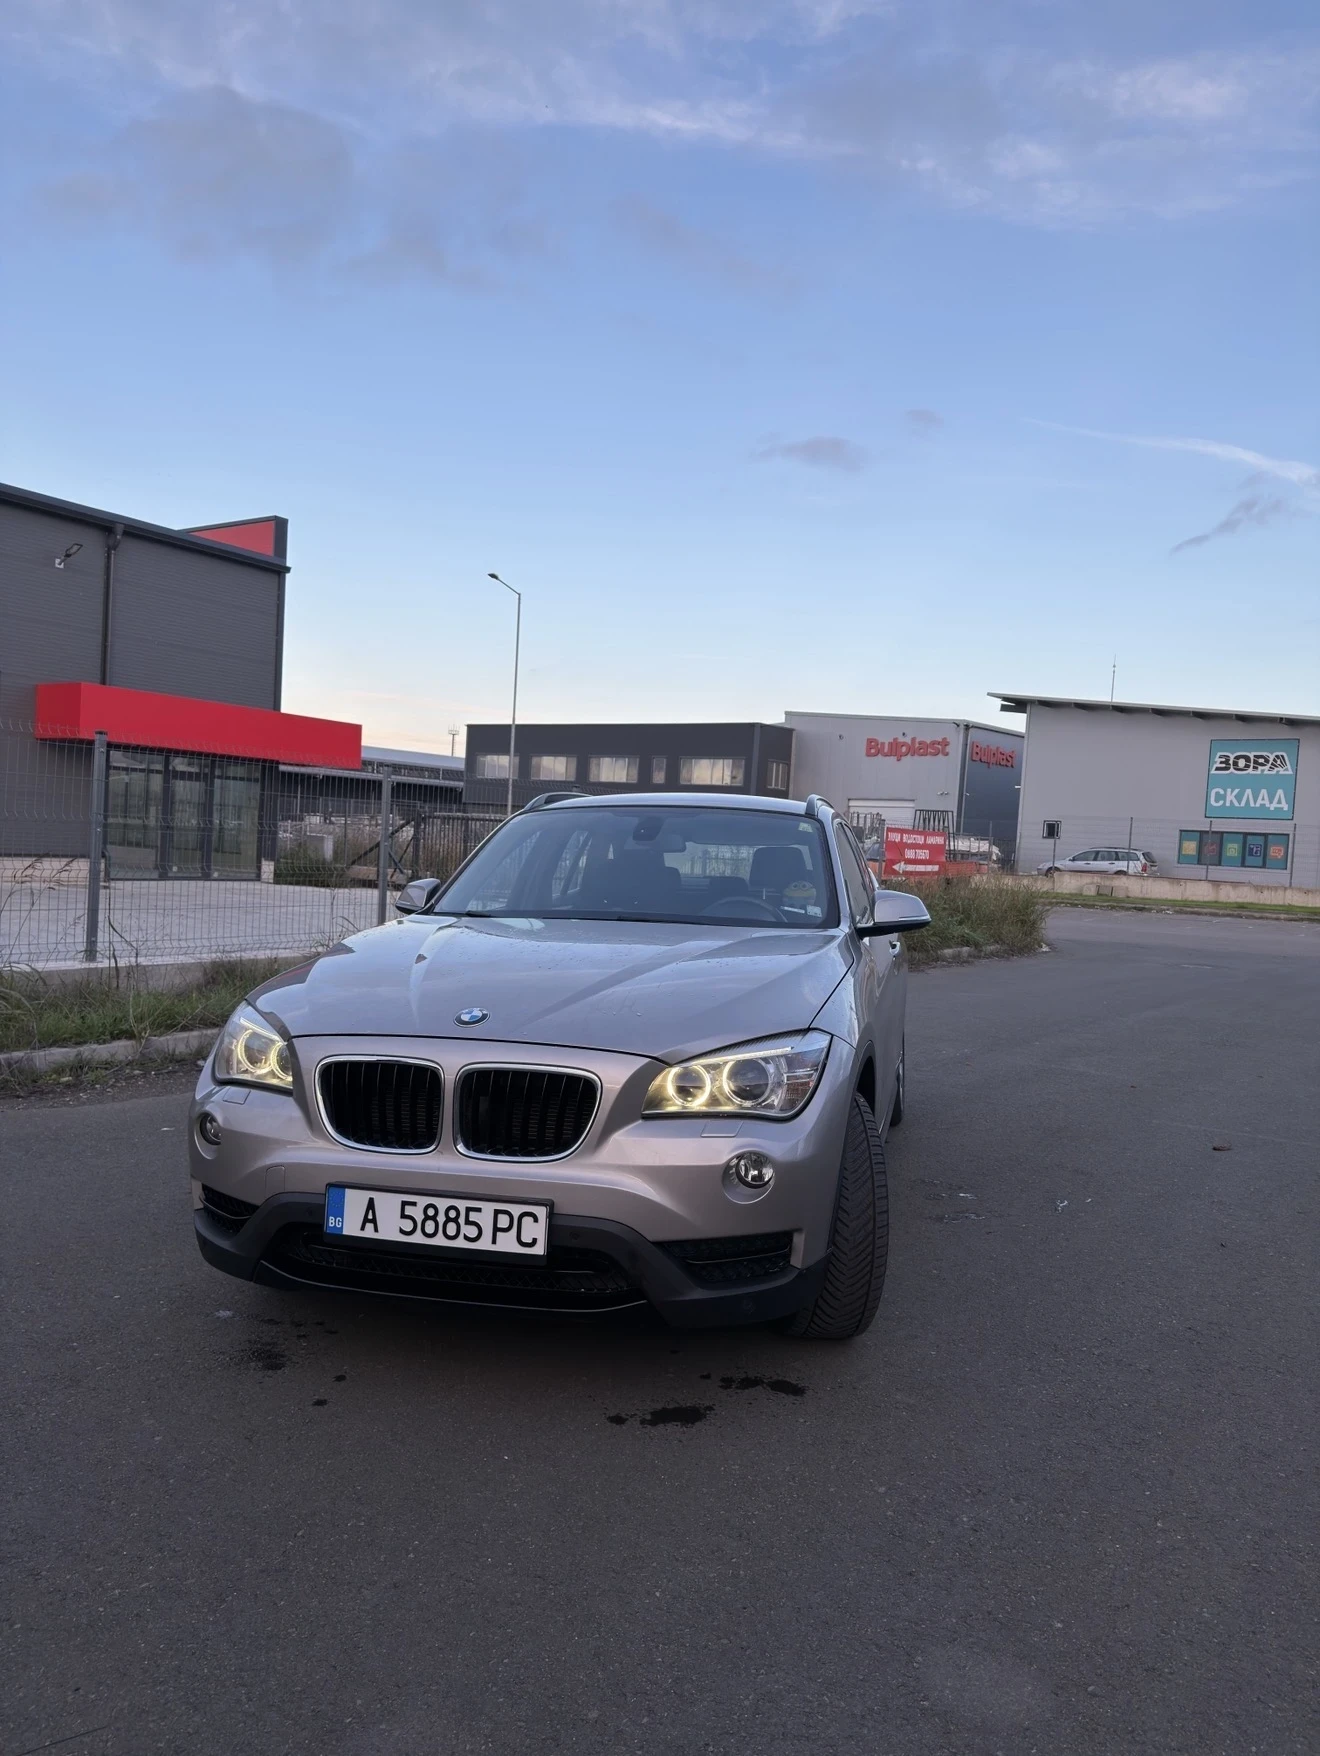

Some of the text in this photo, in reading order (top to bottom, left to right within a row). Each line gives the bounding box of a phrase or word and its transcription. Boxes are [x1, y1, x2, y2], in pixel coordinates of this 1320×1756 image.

[865, 737, 950, 761] Bulplast
[971, 741, 1017, 768] Bulplast
[1211, 752, 1293, 774] ЗОРА
[1210, 787, 1288, 810] СКЛАД
[328, 1216, 342, 1228] BG
[360, 1197, 539, 1248] A 5885 PC
